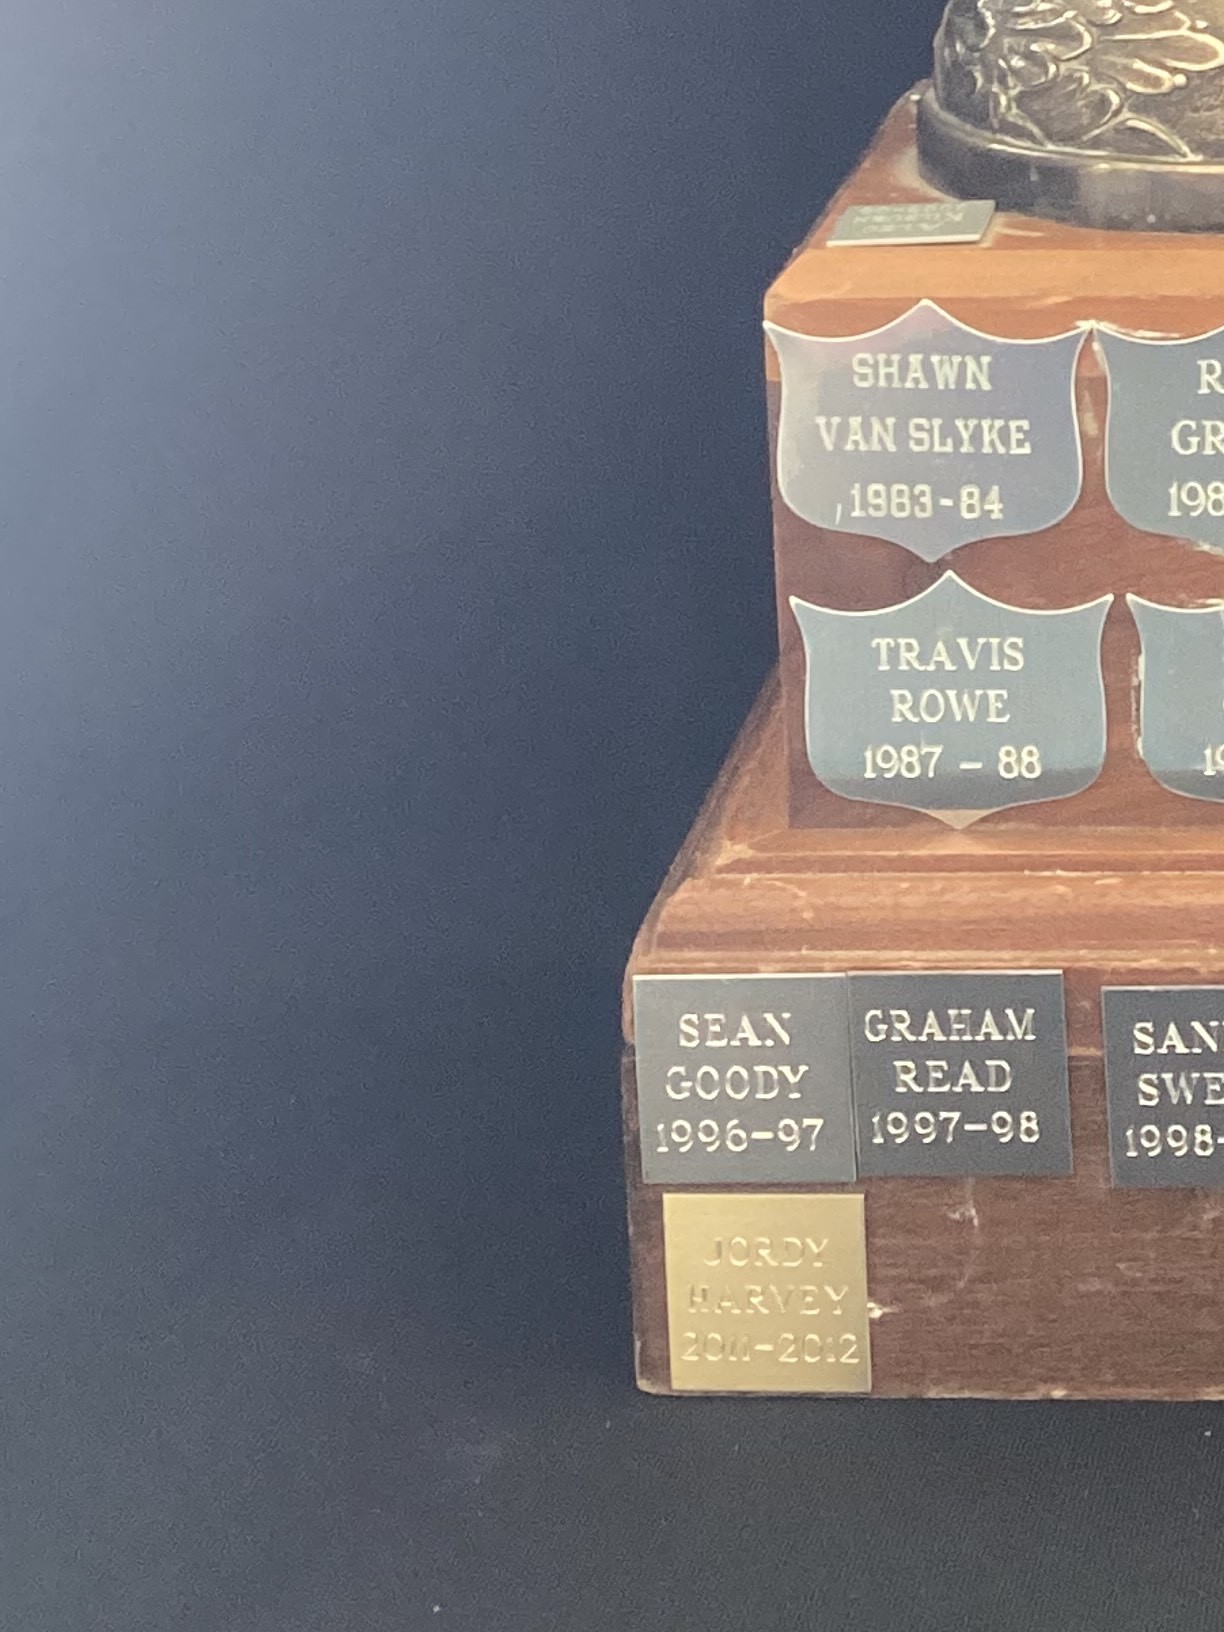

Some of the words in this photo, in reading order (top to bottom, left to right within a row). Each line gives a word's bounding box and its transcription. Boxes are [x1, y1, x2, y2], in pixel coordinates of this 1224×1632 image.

[852, 352, 993, 391] SHAWN
[815, 415, 897, 452] VAN
[908, 417, 1032, 455] SLYKE
[850, 482, 1004, 520] 1983-84
[872, 636, 1025, 673] TRAVIS
[890, 689, 1011, 724] ROWE
[863, 744, 943, 780] 1987
[997, 745, 1042, 780] 88
[678, 1012, 792, 1049] SEAN
[863, 1008, 1038, 1043] GRAHAM
[664, 1065, 809, 1101] GOODY
[894, 1059, 1013, 1094] READ
[655, 1118, 825, 1154] 1996-97
[871, 1110, 1041, 1145] 1997-98
[703, 1235, 830, 1268] JORDY
[687, 1282, 849, 1315] HARVEY
[680, 1331, 860, 1364] 2011-2012
